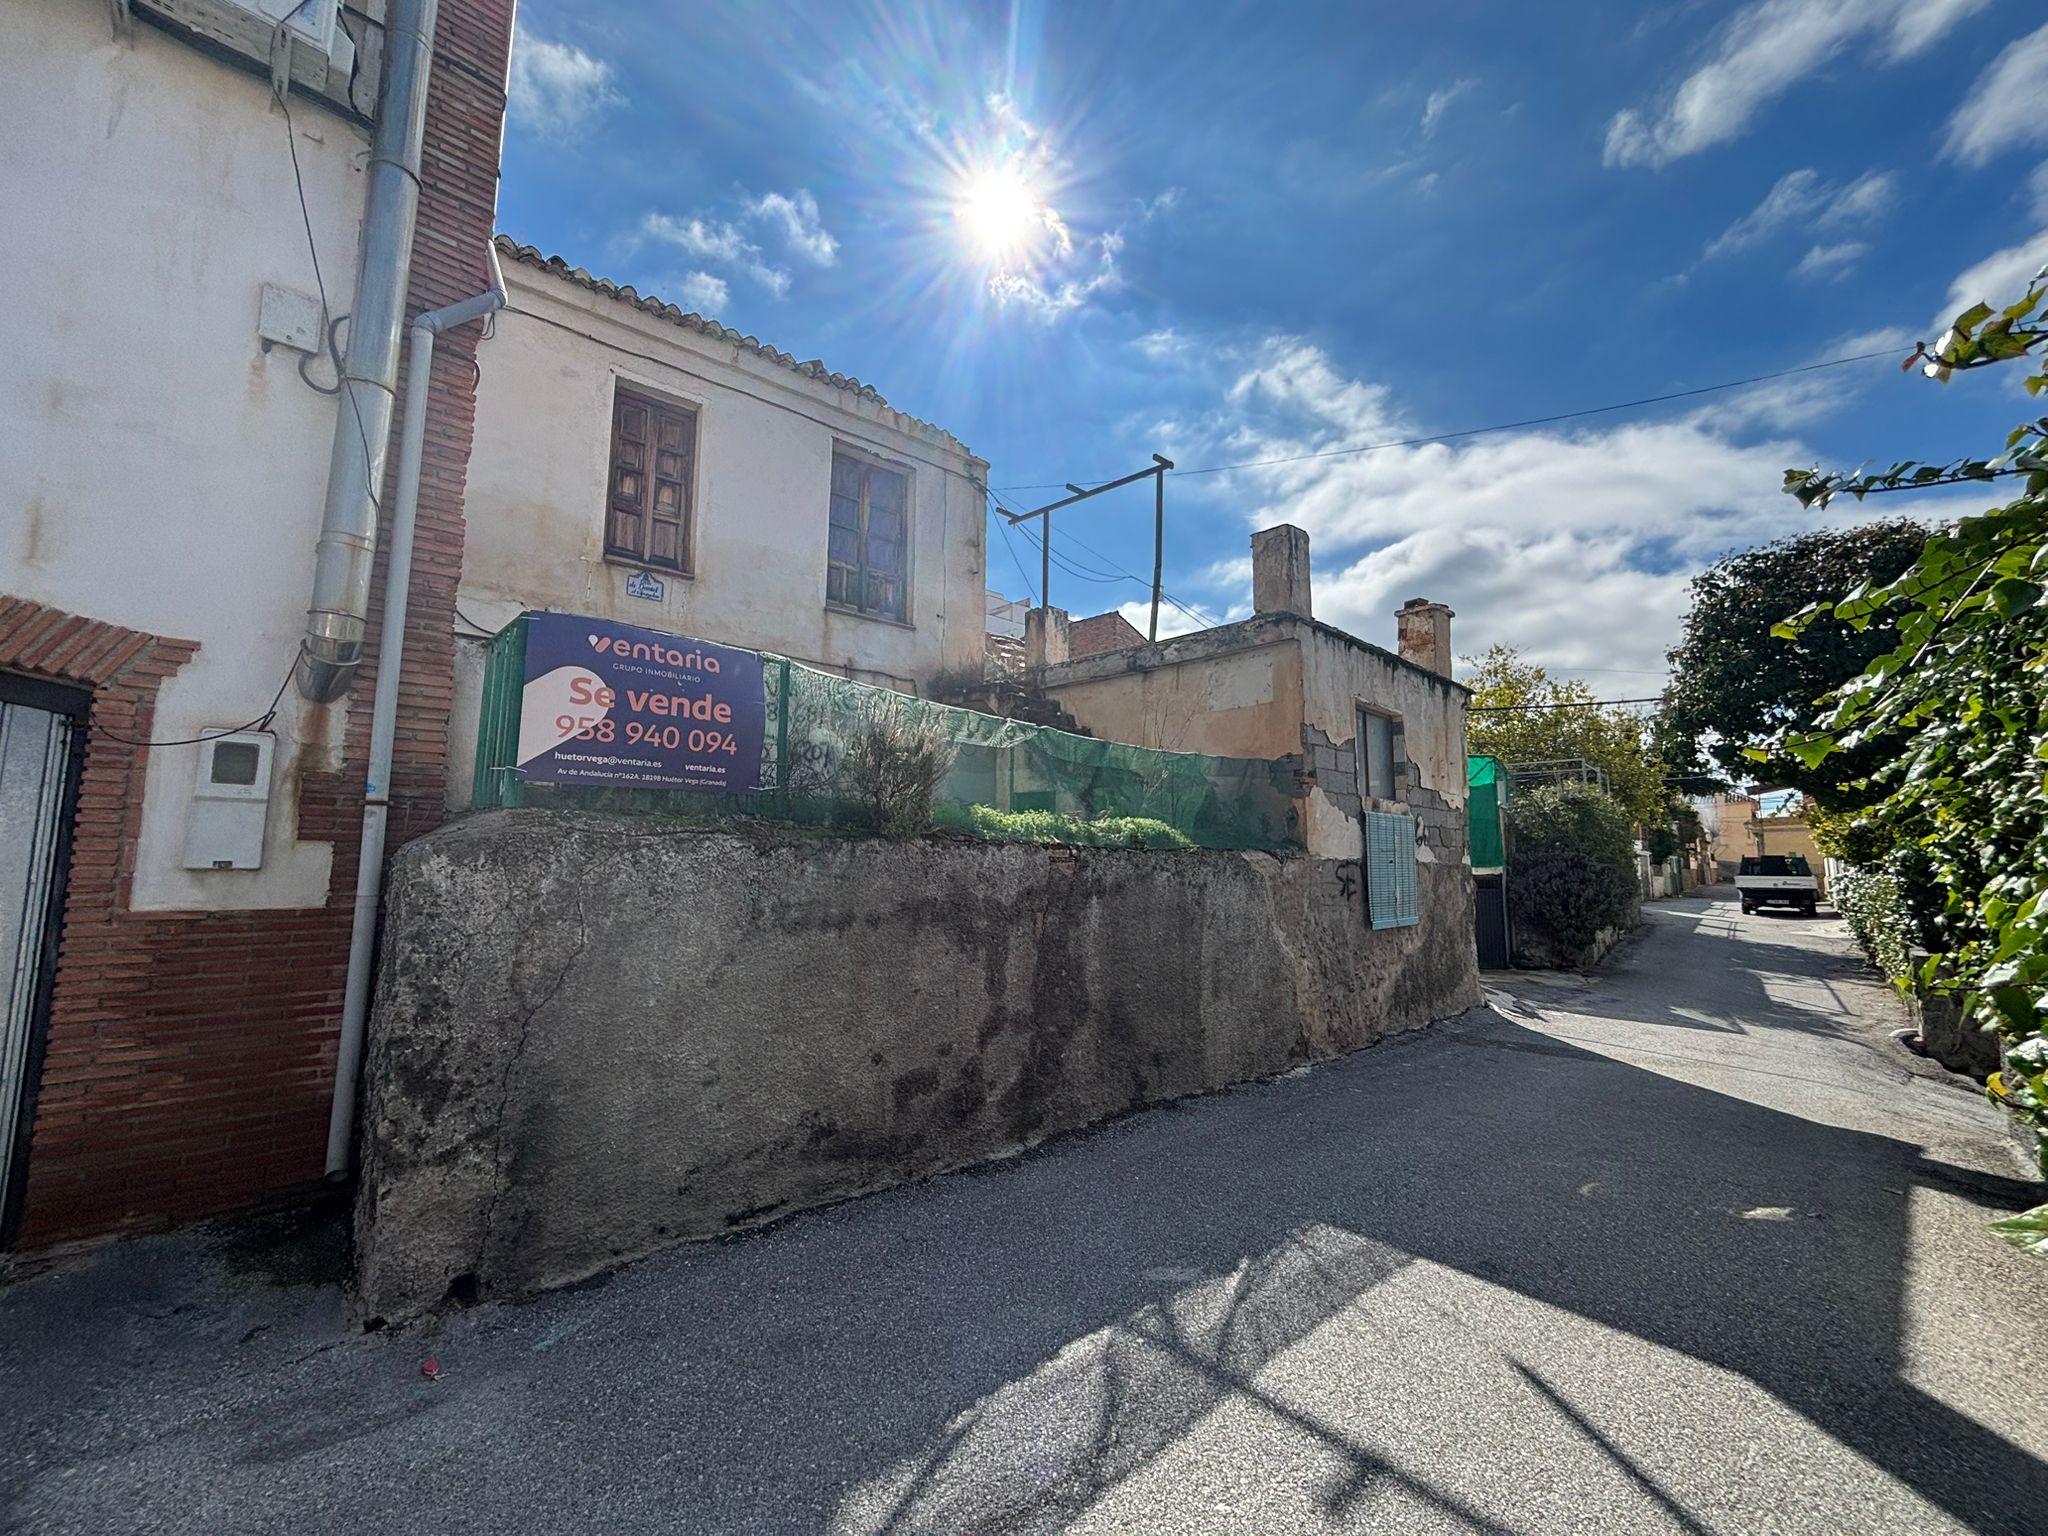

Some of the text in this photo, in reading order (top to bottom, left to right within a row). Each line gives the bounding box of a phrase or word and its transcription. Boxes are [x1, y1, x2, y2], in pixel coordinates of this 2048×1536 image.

[588, 634, 720, 674] ventaria
[613, 663, 701, 683] GRUPO INMOBILIARIO
[569, 677, 615, 709] Se
[627, 690, 731, 724] vende
[555, 714, 737, 756] 958 940 094
[554, 751, 662, 769] huetorvega@ventaria.es
[685, 763, 726, 774] ventaria.es
[568, 768, 578, 776] de
[684, 778, 699, 786] Vega
[700, 779, 727, 787] (Granada)
